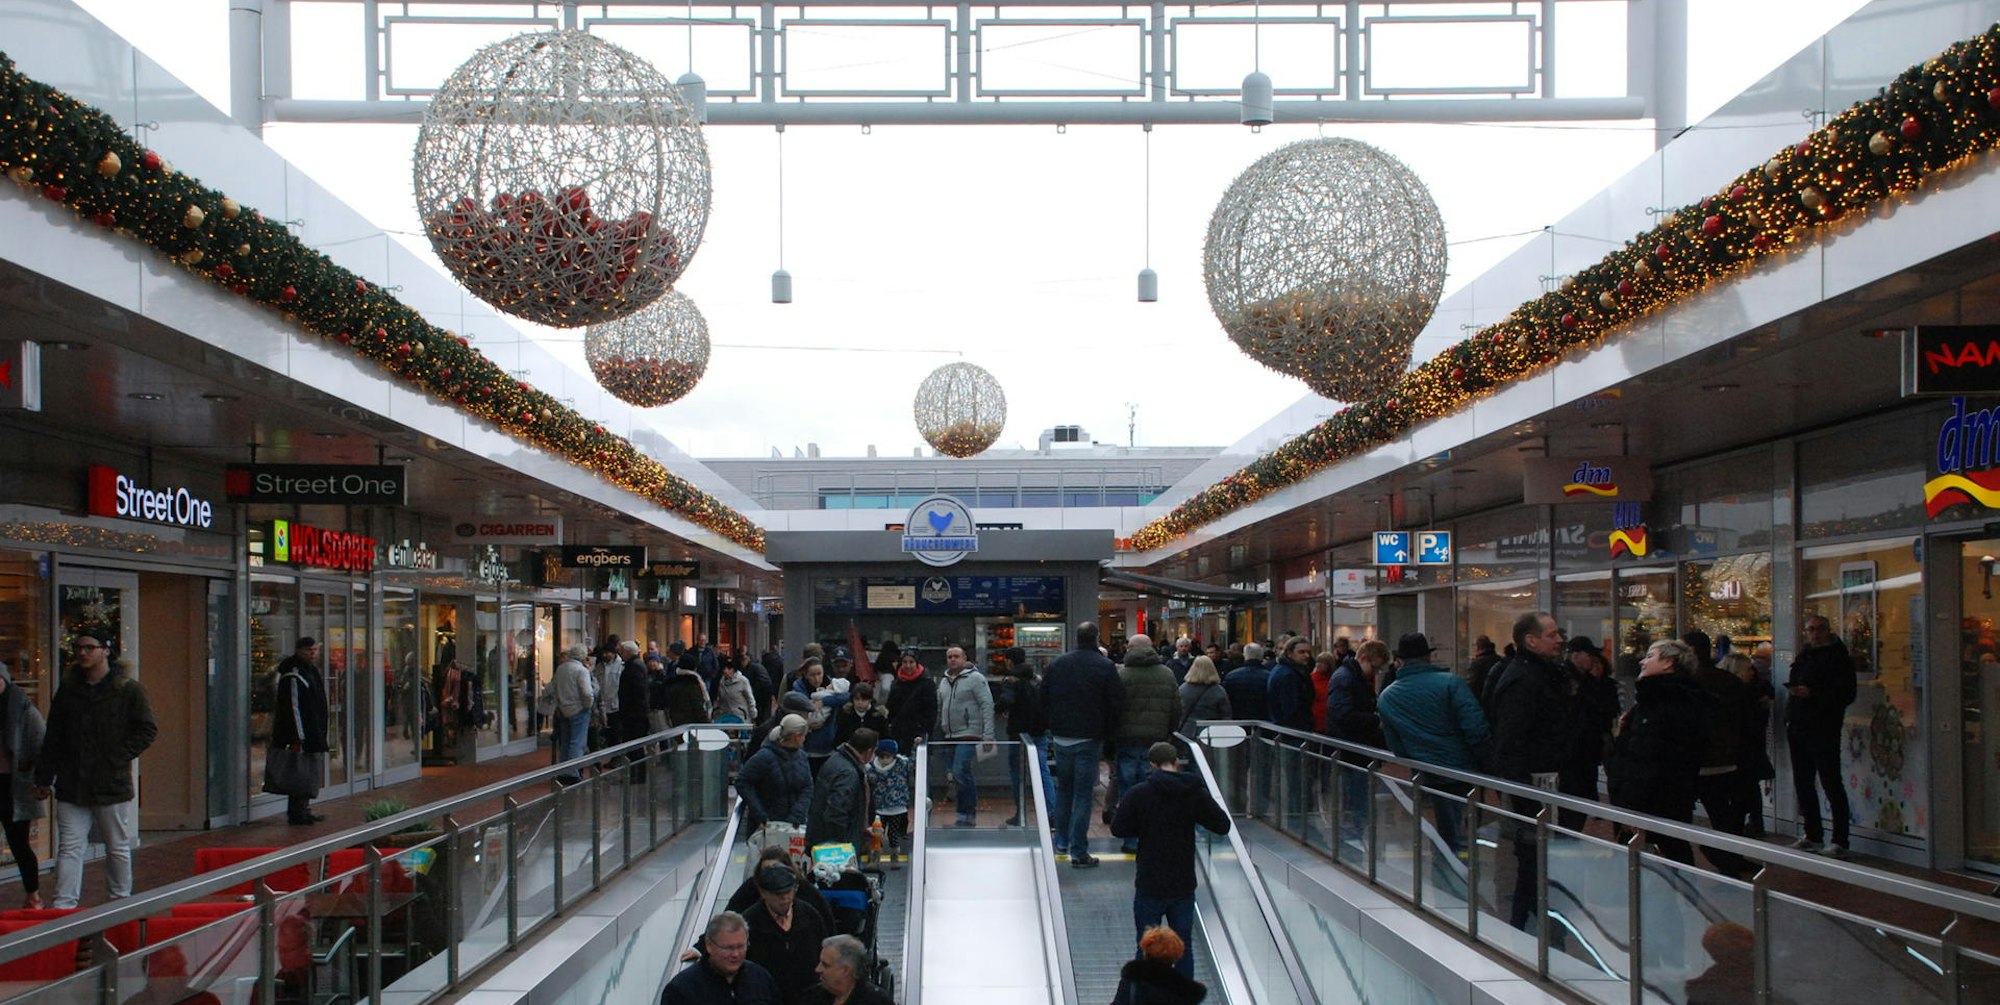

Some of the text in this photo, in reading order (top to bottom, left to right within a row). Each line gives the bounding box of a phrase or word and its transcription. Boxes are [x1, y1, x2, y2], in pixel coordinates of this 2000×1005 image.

[1572, 461, 1612, 484] dm
[256, 473, 397, 495] Street One
[116, 474, 212, 528] Street One
[479, 523, 555, 537] CIGARREN
[1378, 533, 1399, 546] WC
[289, 522, 377, 572] WOLSDORFF
[1419, 533, 1438, 556] P
[576, 553, 632, 567] engbers
